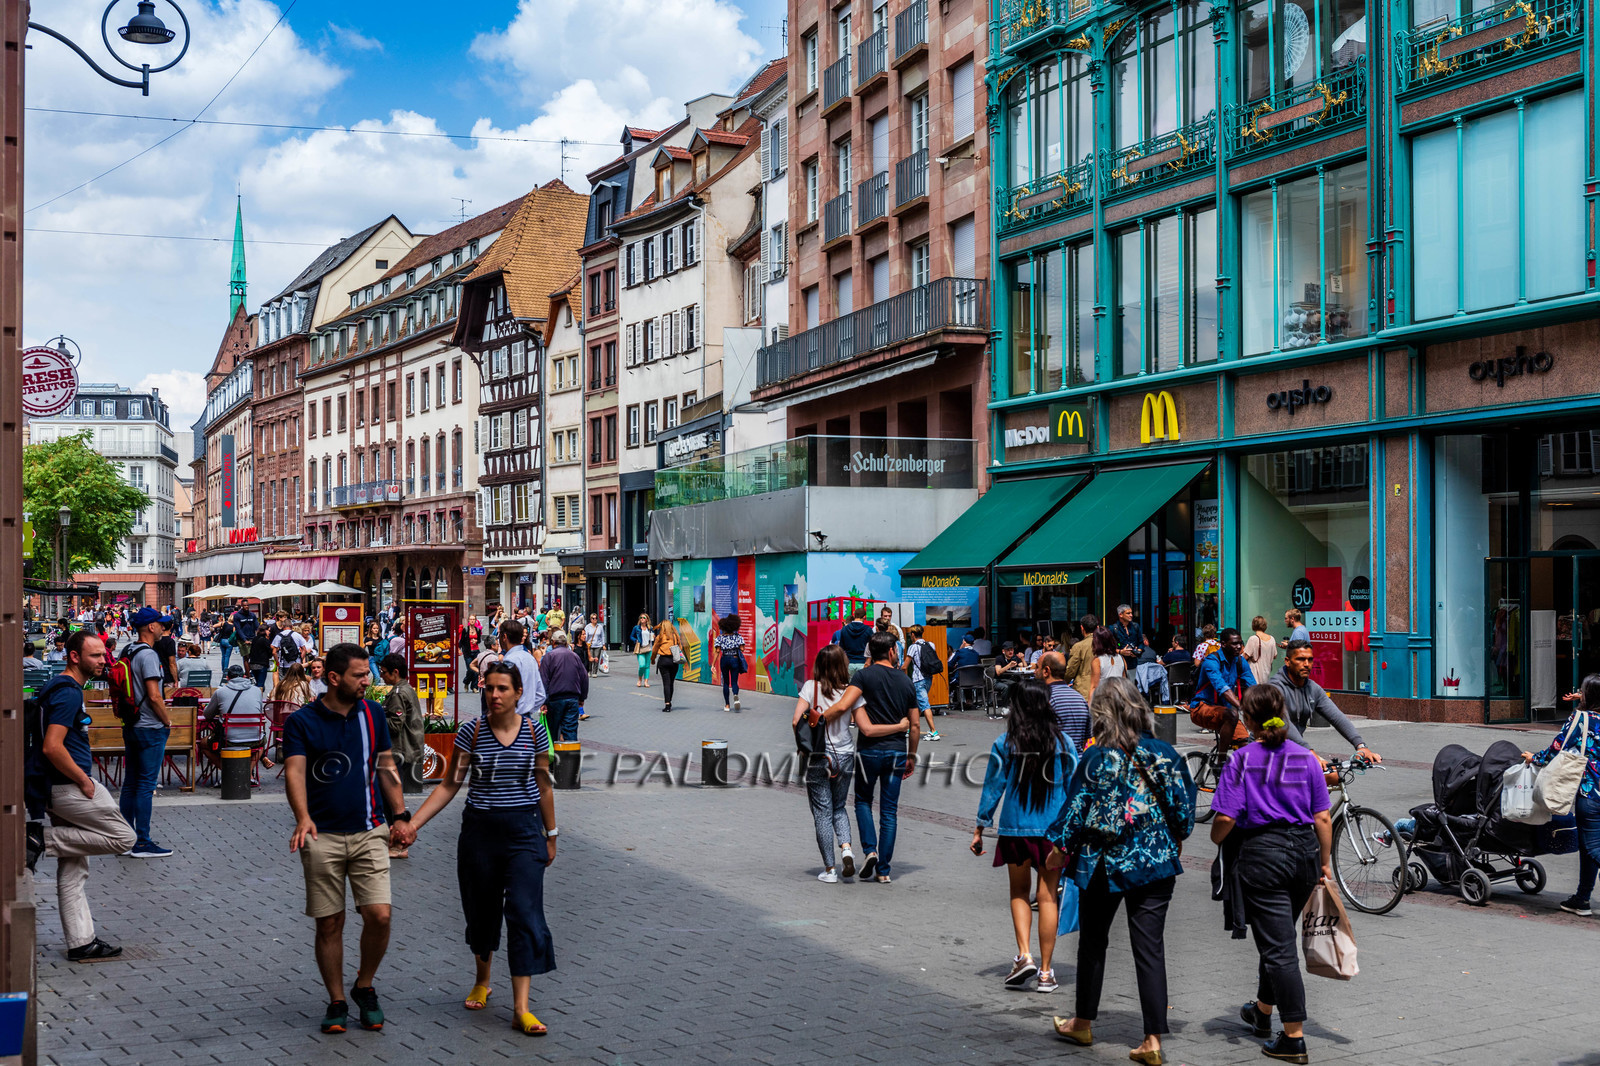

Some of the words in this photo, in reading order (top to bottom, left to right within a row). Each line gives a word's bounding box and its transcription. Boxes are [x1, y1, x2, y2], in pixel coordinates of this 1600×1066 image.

[1468, 346, 1554, 387] oysho
[23, 367, 74, 386] RESH
[23, 380, 76, 395] URRITOS
[1266, 380, 1332, 415] oysho
[853, 451, 946, 477] Schutzenberger
[224, 453, 232, 498] MONOPRIX
[605, 556, 622, 570] celio
[921, 575, 961, 588] McDonald's
[1023, 571, 1069, 586] McDonald's
[1312, 616, 1357, 627] SOLDES
[1311, 632, 1337, 640] SOLDES
